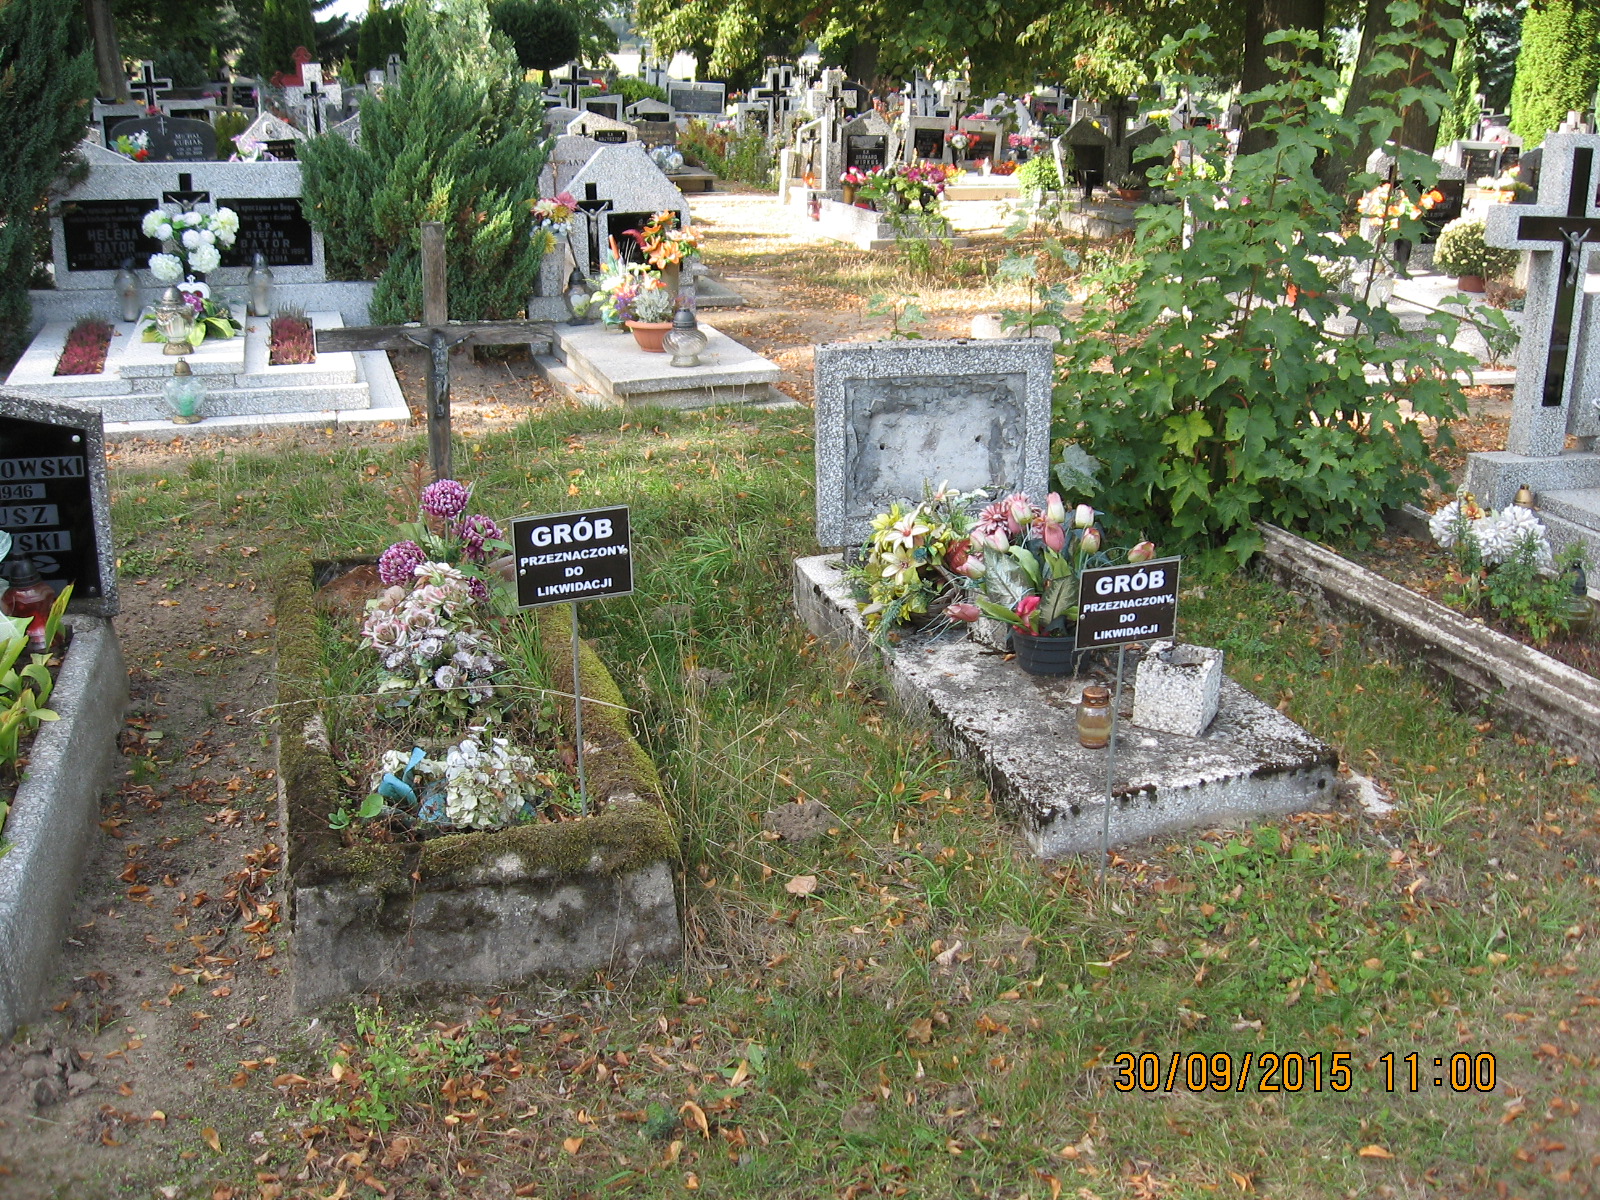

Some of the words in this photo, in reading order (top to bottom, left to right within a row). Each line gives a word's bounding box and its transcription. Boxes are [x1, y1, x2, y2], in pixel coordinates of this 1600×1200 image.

[87, 229, 139, 241] HELENA
[245, 230, 284, 238] STEFAN
[94, 241, 136, 253] BATOR
[240, 239, 291, 248] BATOR
[0, 485, 33, 499] 946
[530, 516, 614, 547] GRÓB
[12, 533, 60, 552] SKI
[520, 544, 625, 567] PRZEZNACZONY
[565, 566, 584, 577] DO
[537, 578, 613, 597] LIKWIDACJI
[1095, 568, 1165, 595] GRÓB
[1083, 593, 1173, 613] PRZEZNACZONY
[1119, 613, 1136, 623] DO
[1094, 624, 1158, 640] LIKWIDACJI
